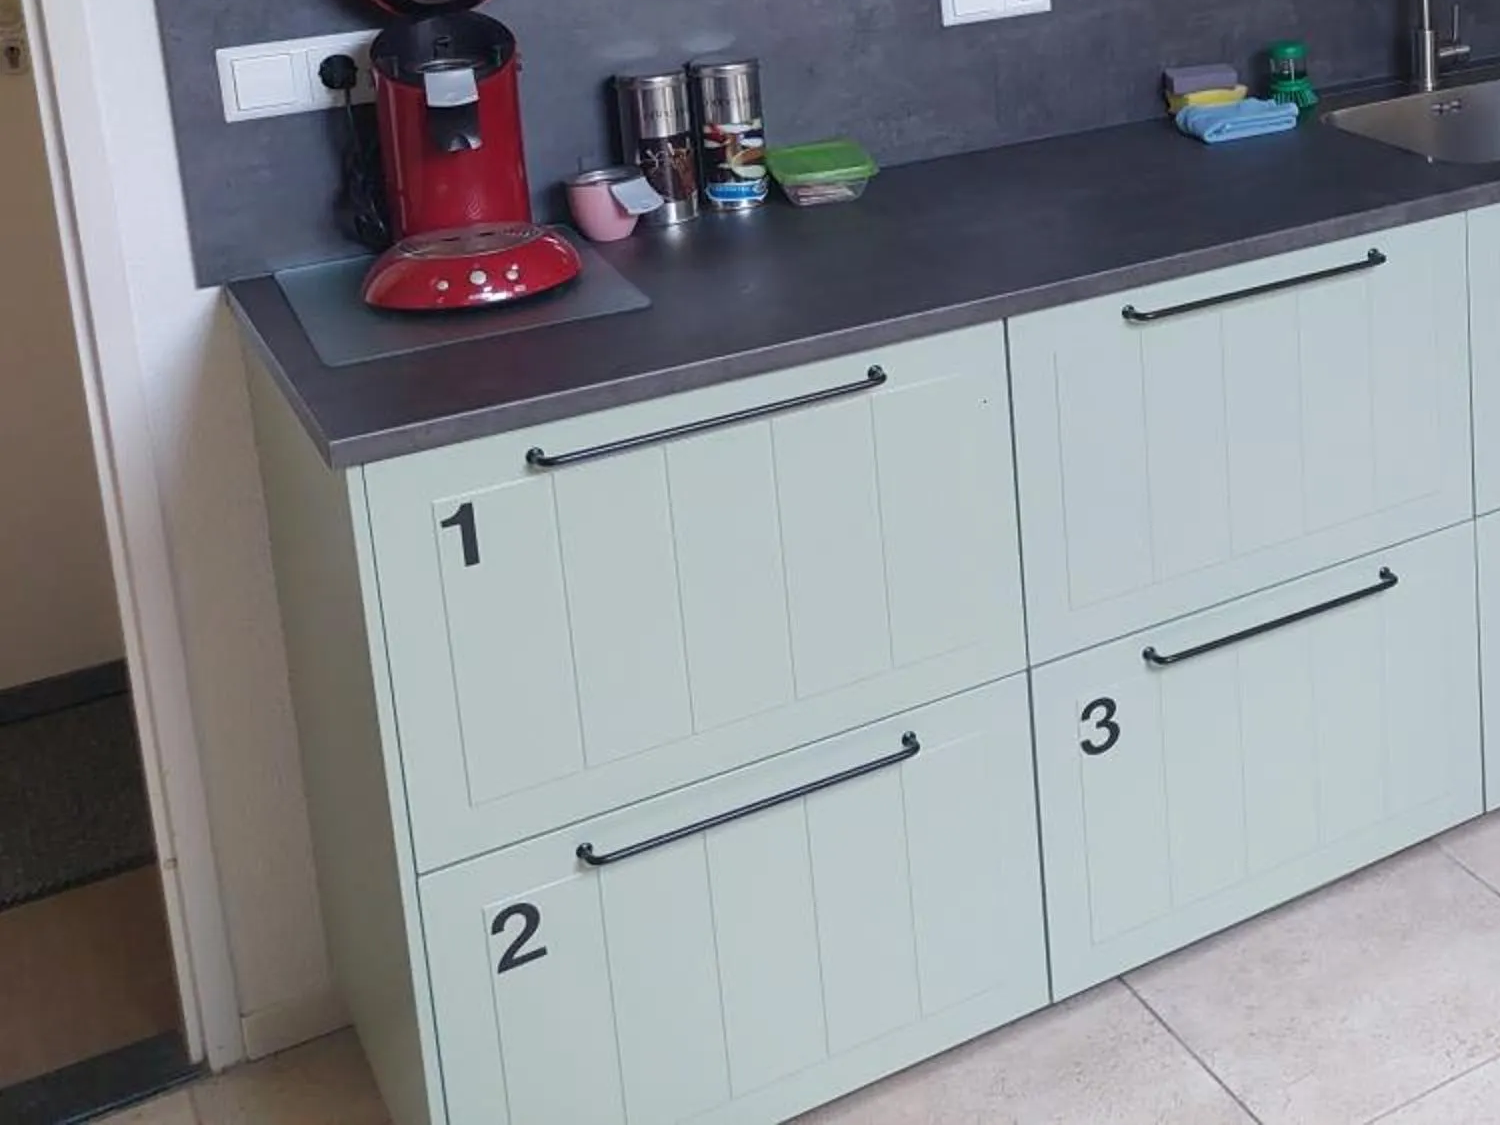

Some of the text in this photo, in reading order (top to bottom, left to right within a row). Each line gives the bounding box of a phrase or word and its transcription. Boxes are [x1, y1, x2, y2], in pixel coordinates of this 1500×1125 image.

[440, 501, 480, 567] 1
[1080, 697, 1121, 756] 3
[491, 902, 547, 974] 2
